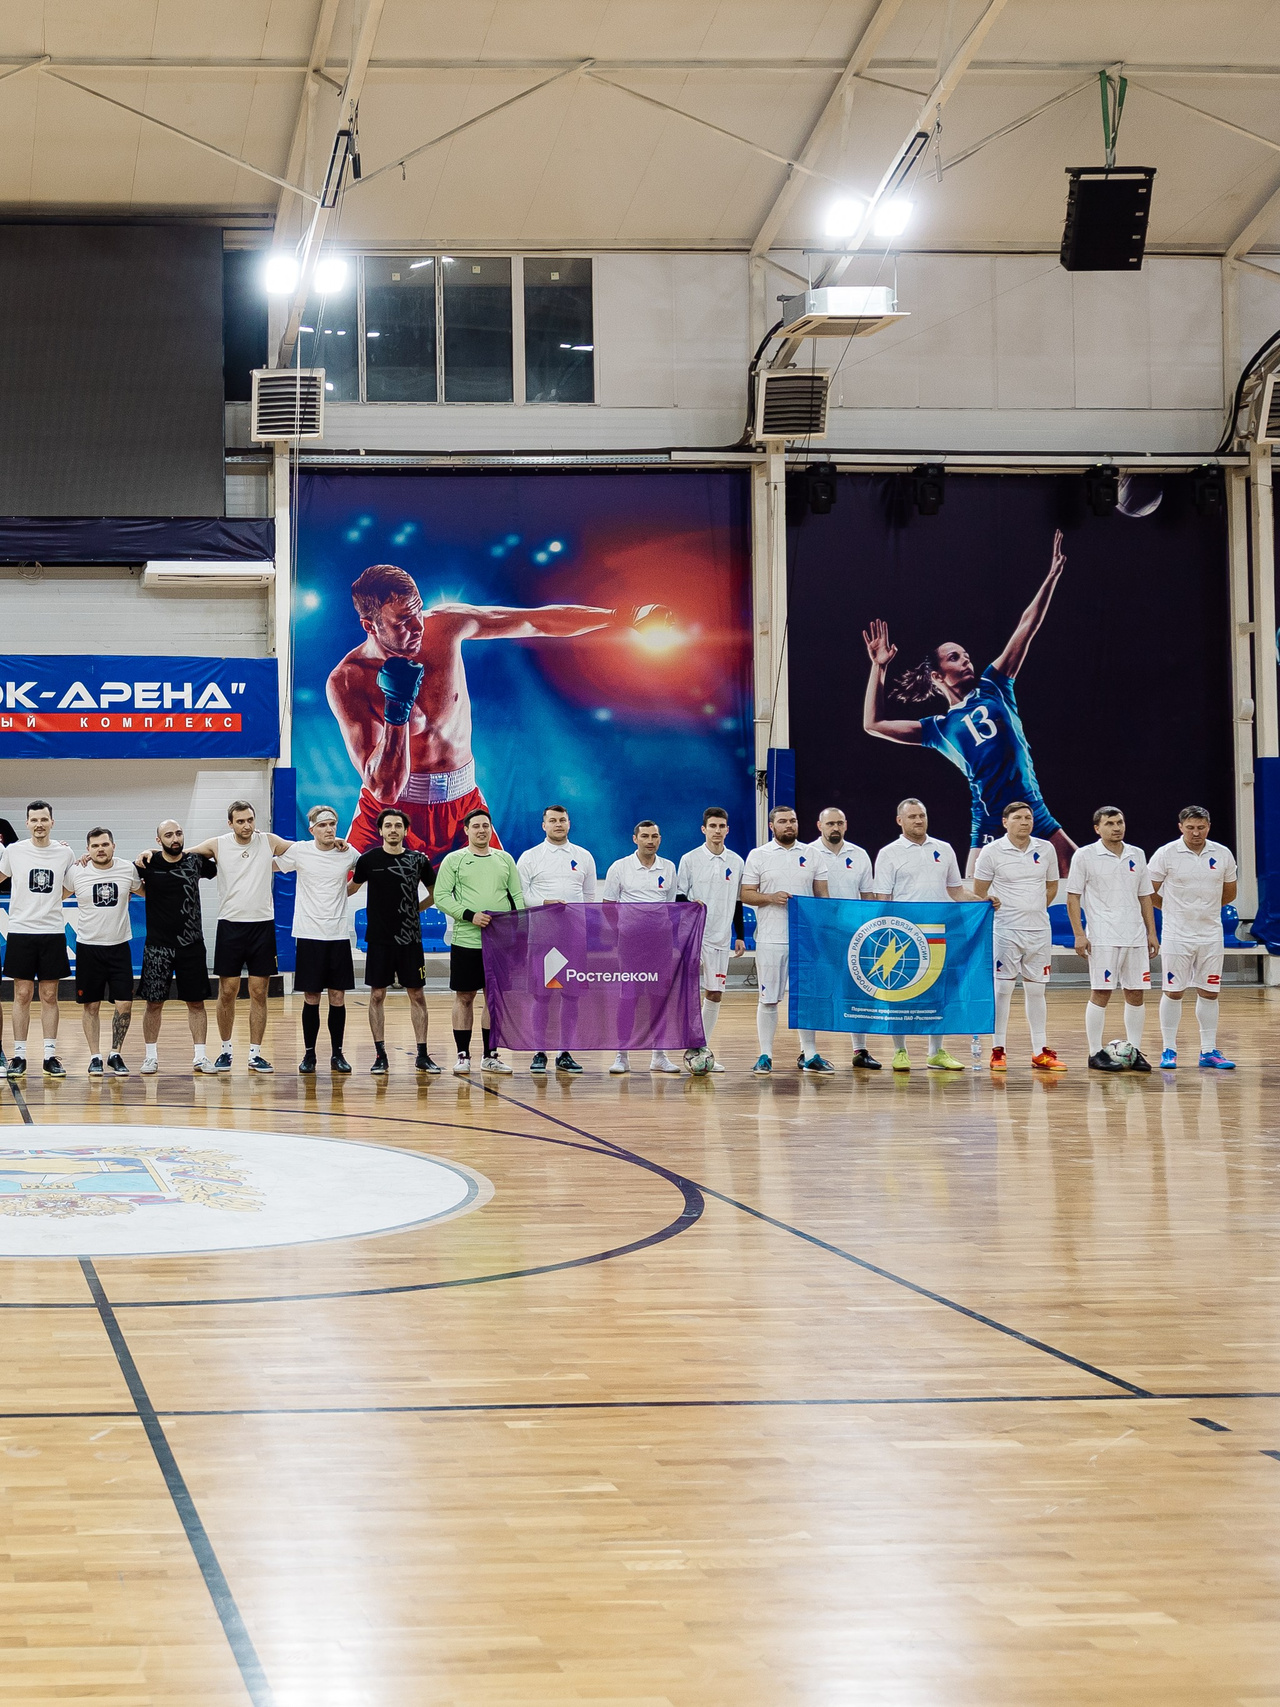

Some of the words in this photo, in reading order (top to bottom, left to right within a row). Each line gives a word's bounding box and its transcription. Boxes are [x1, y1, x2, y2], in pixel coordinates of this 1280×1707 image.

[80, 717, 233, 729] КОМПЛЕКС
[961, 705, 998, 747] 13
[852, 919, 887, 951] РАБОТНИКОВ
[890, 919, 914, 933] СВЯЗИ
[913, 931, 928, 961] РОССИИ
[566, 969, 659, 982] Ростелеком
[851, 954, 873, 993] ПРОФСОЮЗ
